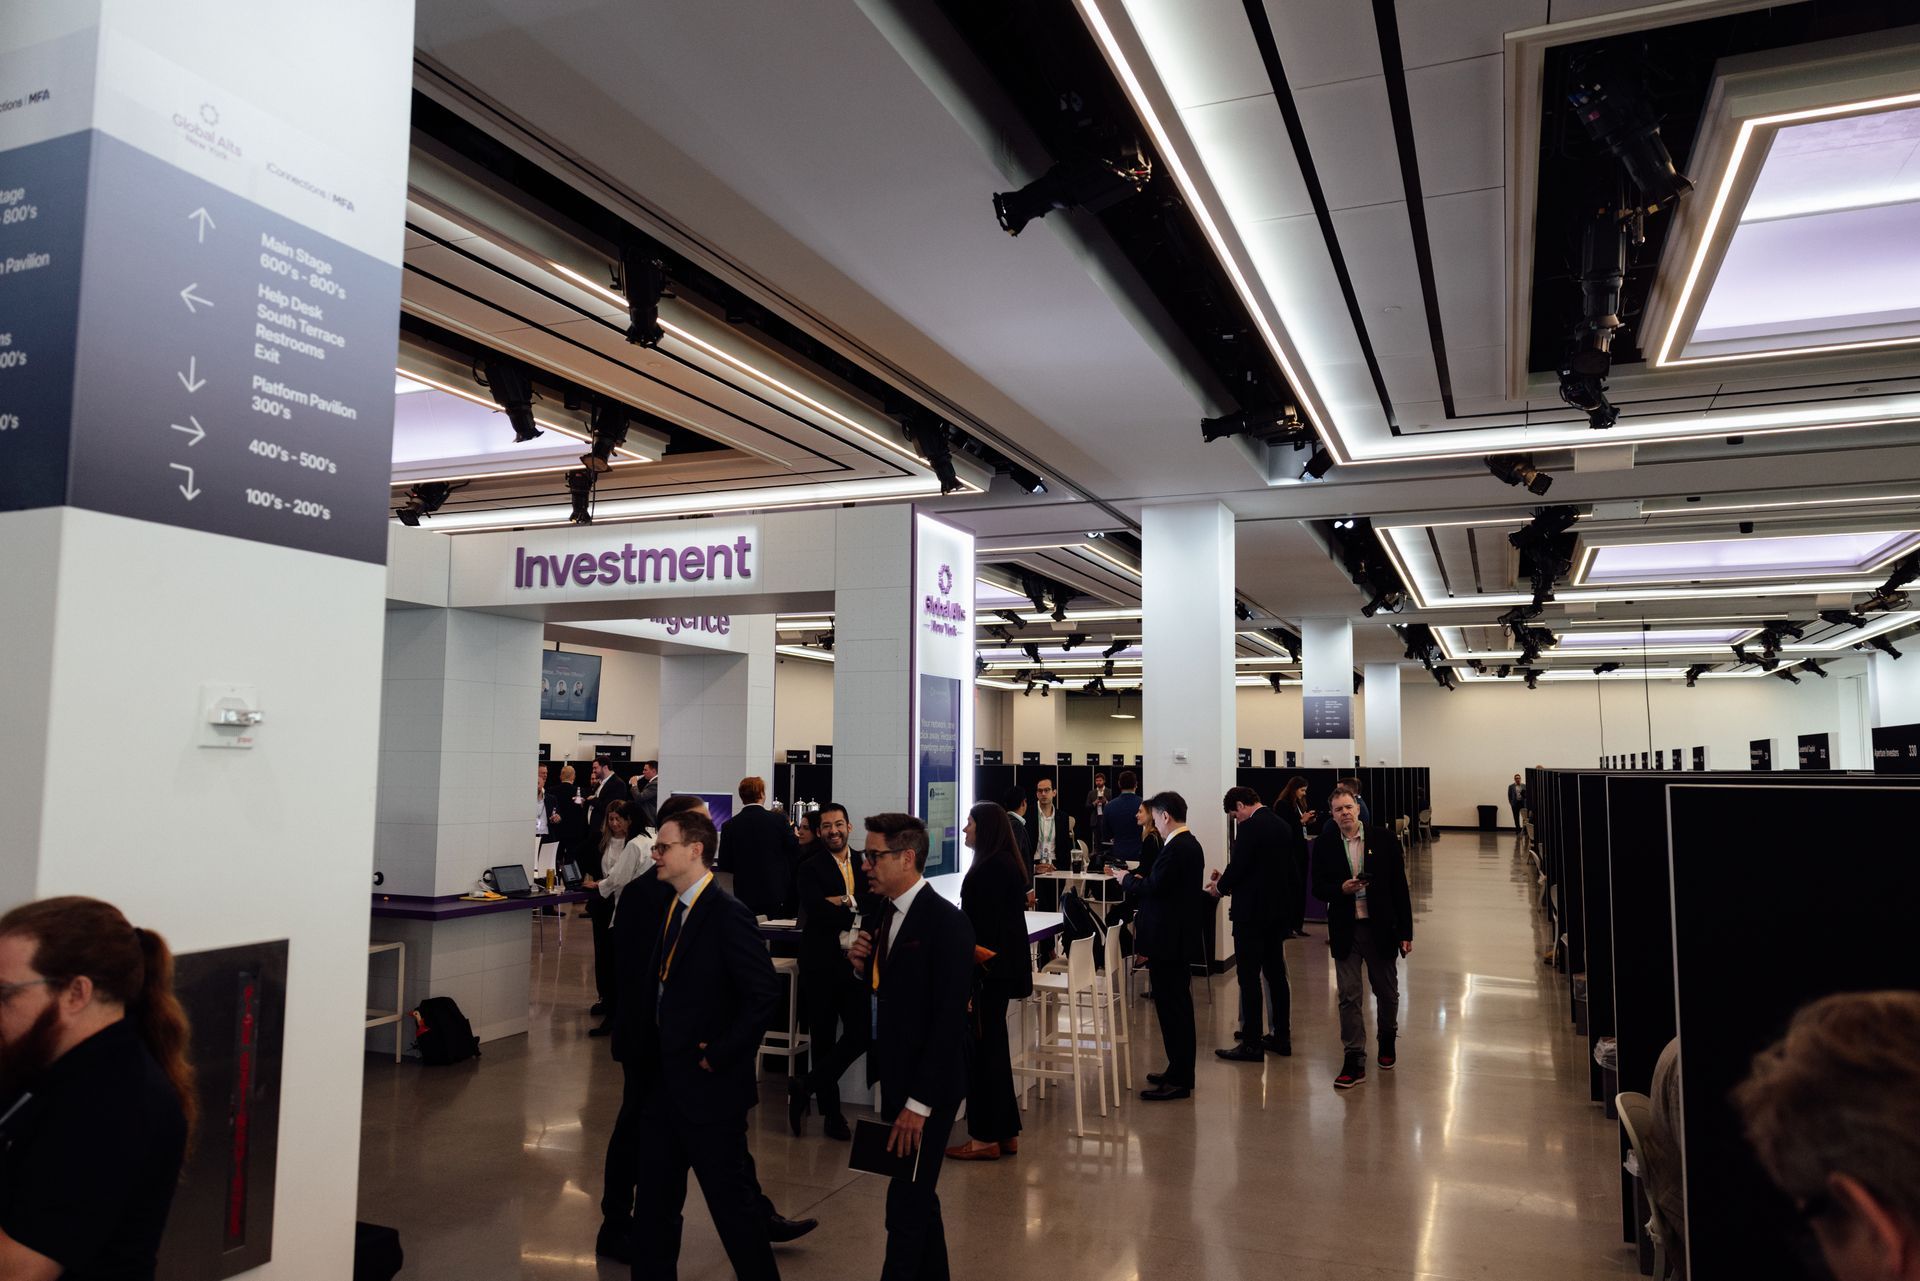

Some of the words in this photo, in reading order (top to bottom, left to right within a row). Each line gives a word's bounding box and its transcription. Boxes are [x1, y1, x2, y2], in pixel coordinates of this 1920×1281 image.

[29, 89, 50, 104] MFA
[172, 113, 216, 143] Global
[217, 136, 243, 158] Alts
[0, 187, 25, 206] tage
[332, 193, 356, 212] MFA
[3, 204, 38, 225] 800's
[6, 252, 50, 274] Pavilion
[261, 231, 294, 259] Main
[295, 247, 333, 275] Stage
[260, 252, 300, 281] 600's
[309, 273, 347, 300] 800's
[258, 282, 290, 309] Help
[291, 295, 323, 320] Desk
[256, 303, 297, 330] South
[298, 318, 346, 348] Terrace
[254, 342, 280, 364] Exit
[255, 322, 325, 360] Restrooms
[0, 351, 28, 369] 00's
[251, 395, 292, 420] 300's
[252, 374, 309, 406] Platform
[309, 392, 357, 420] Pavilion
[0, 413, 19, 430] 0's
[248, 439, 289, 462] 400's
[299, 451, 338, 474] 500's
[245, 488, 283, 511] 100's
[292, 498, 331, 520] 200's
[515, 536, 751, 588] Investment
[925, 594, 950, 619] Global
[951, 602, 966, 622] Alts
[931, 619, 945, 634] New
[944, 622, 958, 637] York
[1908, 744, 1917, 757] 330
